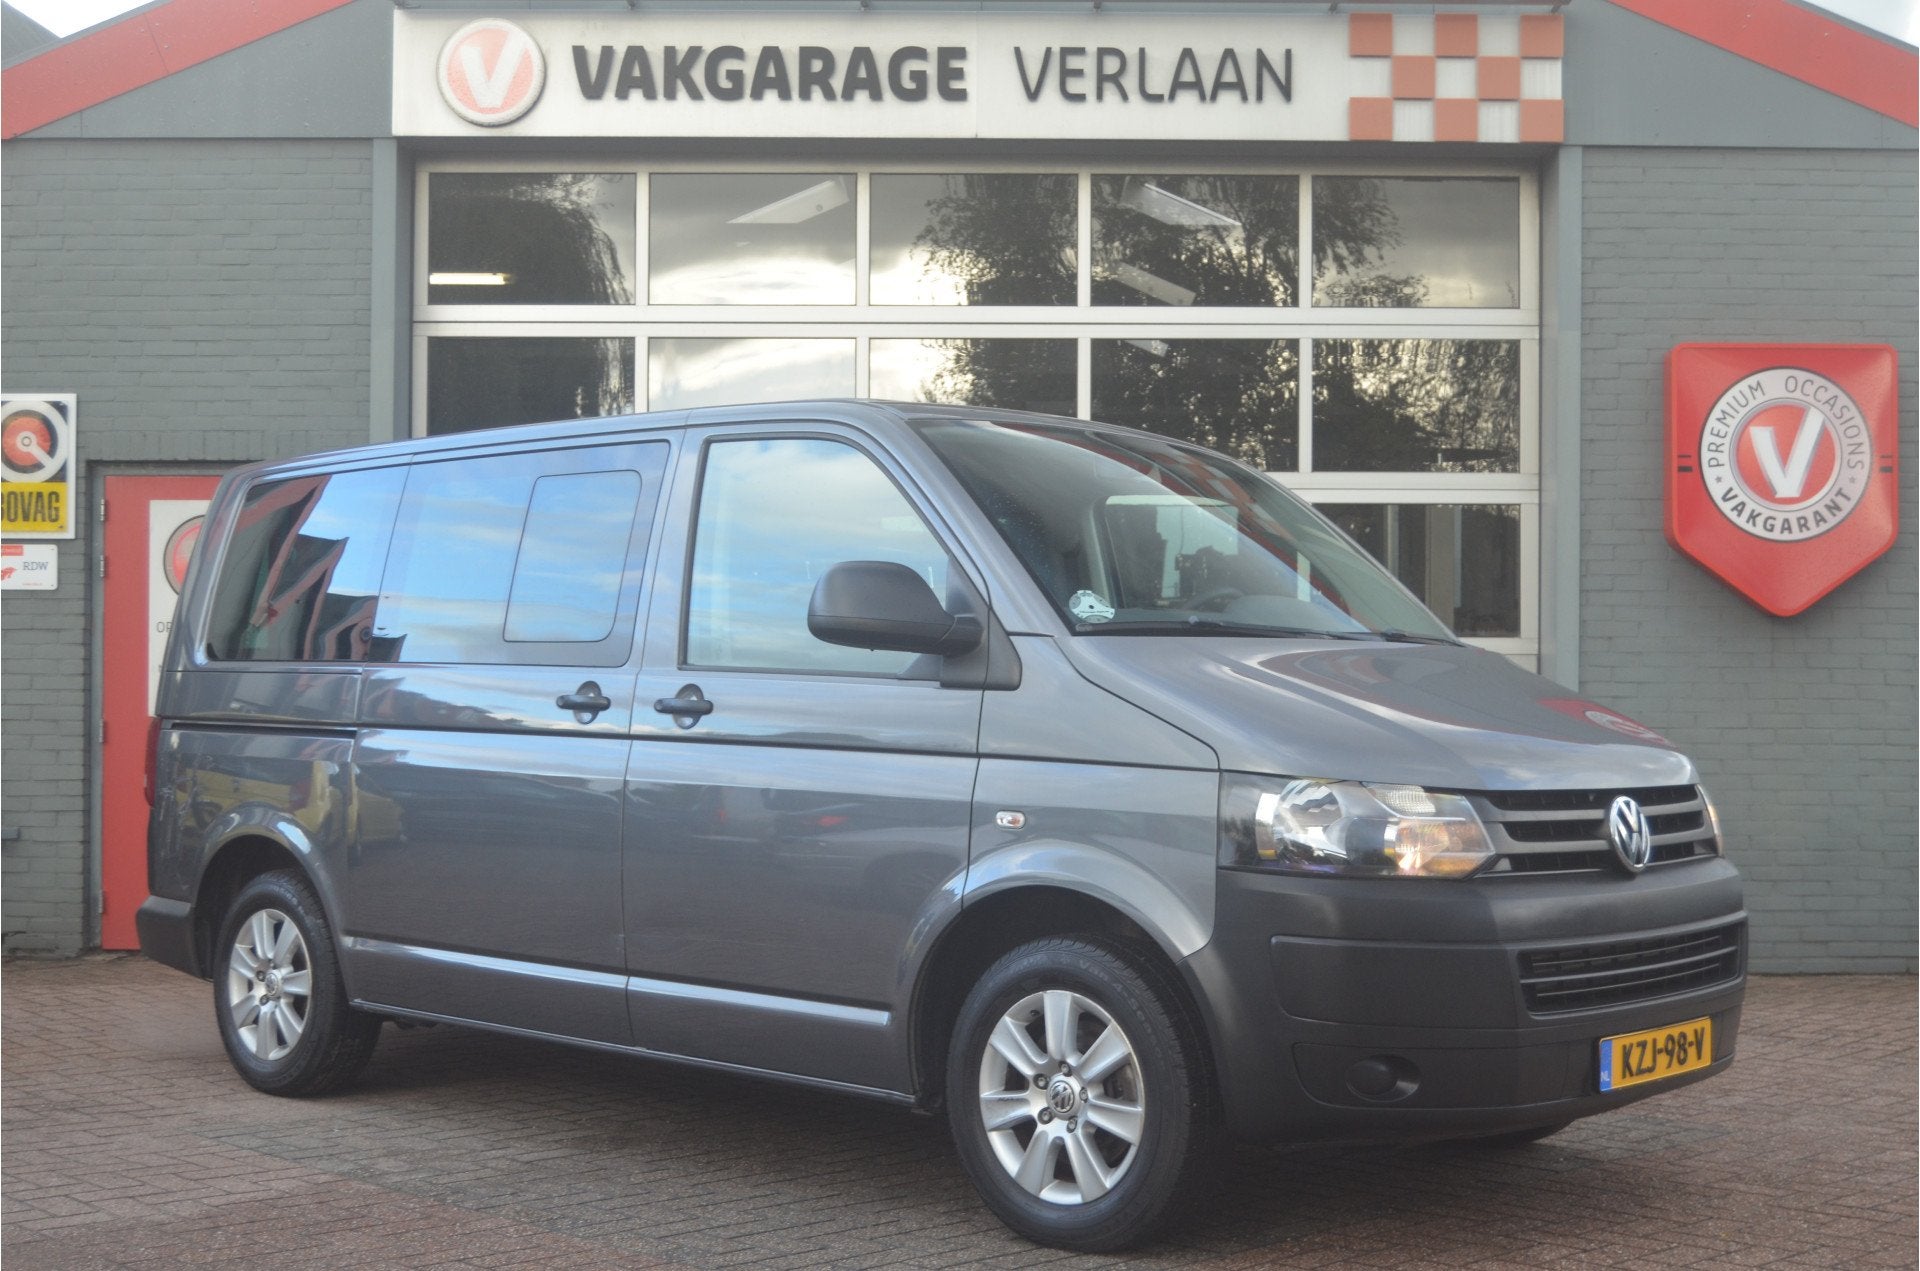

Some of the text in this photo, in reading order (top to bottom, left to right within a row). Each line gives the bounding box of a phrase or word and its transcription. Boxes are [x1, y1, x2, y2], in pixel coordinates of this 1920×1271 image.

[571, 45, 1293, 103] VAKGARAGE VERLAAN
[1708, 375, 1865, 471] PREMIUM OCCASIONS
[1, 491, 60, 522] OVAG
[1720, 487, 1852, 535] VAKGARANT
[22, 561, 49, 571] RDW
[1600, 1071, 1610, 1082] NL
[1621, 1026, 1705, 1079] KZJ-98-V
